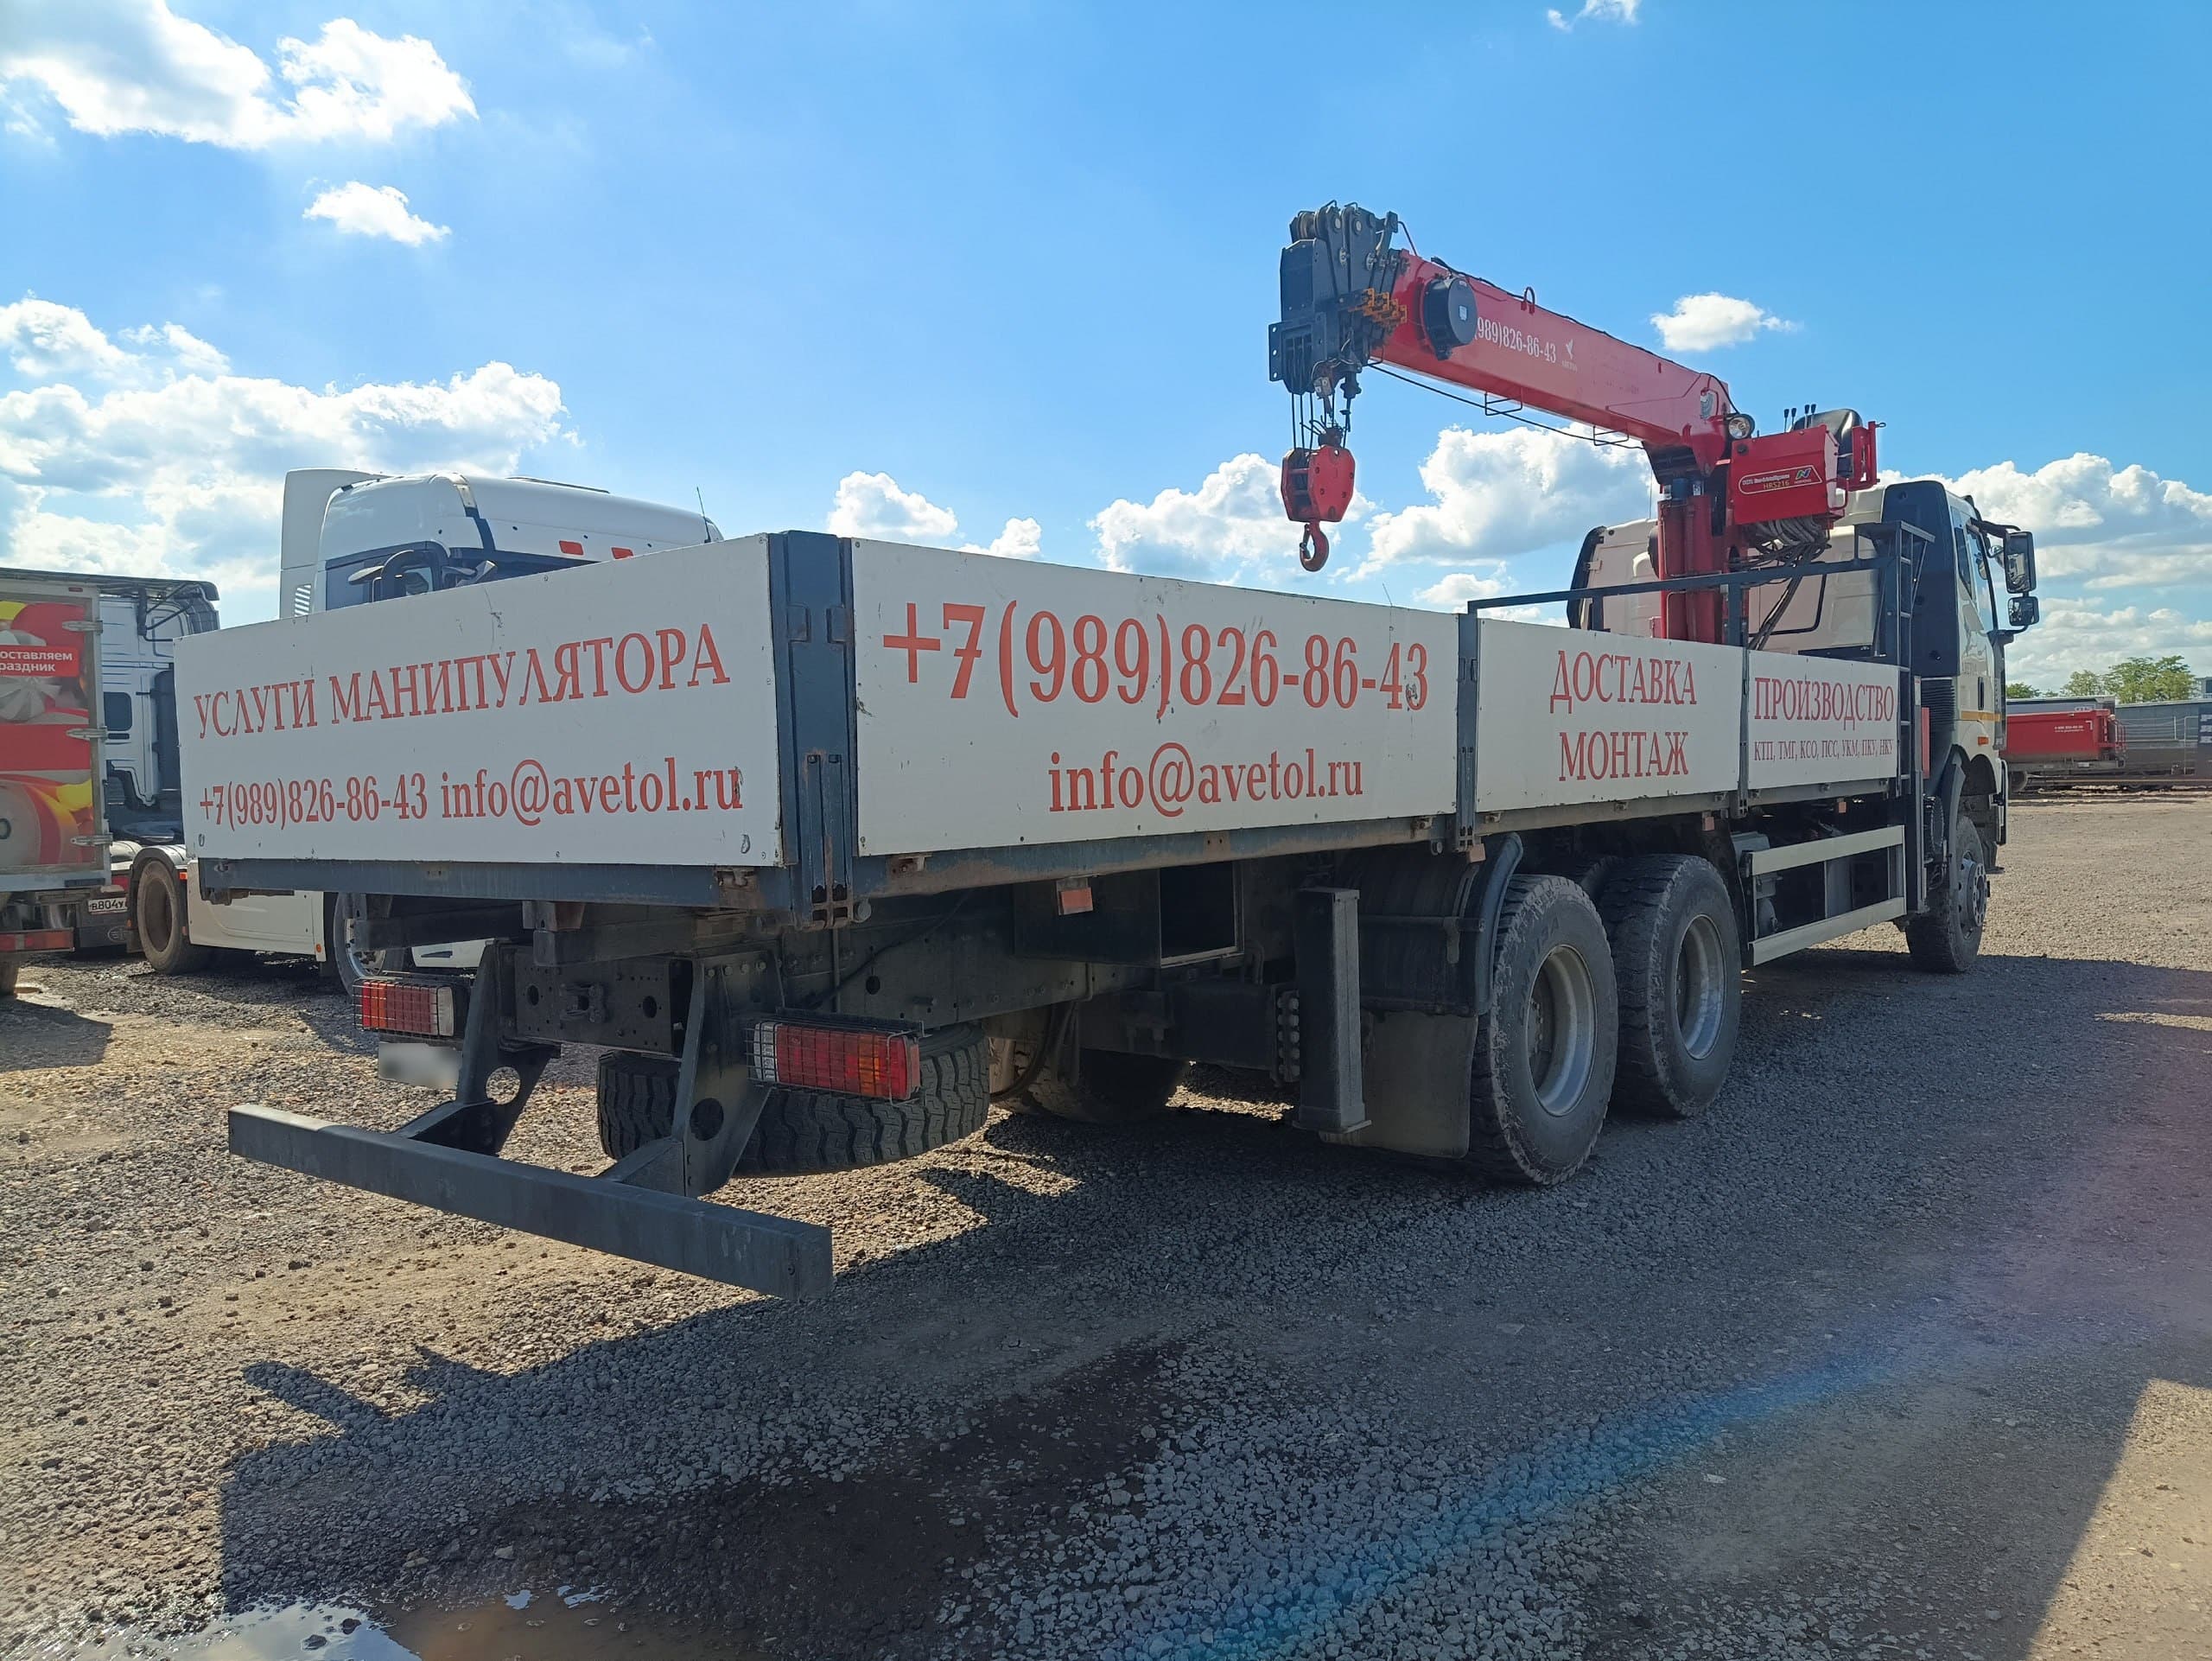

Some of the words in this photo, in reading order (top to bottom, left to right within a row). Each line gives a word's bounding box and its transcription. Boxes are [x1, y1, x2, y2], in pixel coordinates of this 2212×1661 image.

[0, 651, 73, 661] оставляем
[194, 678, 318, 739] УСЛУГИ
[328, 623, 731, 724] МАНИПУЛЯТОРА
[883, 601, 1428, 719] +7(989)826-86-43
[1549, 650, 1697, 714] ДОСТАВКА
[1754, 677, 1895, 730] ПРОИЗВОДСТВО
[1048, 742, 1363, 818] info@avetol.ru
[1559, 731, 1689, 781] МОНТАЖ
[200, 773, 429, 831] +7(989)826-86-43
[441, 757, 743, 826] info@avetol.ru
